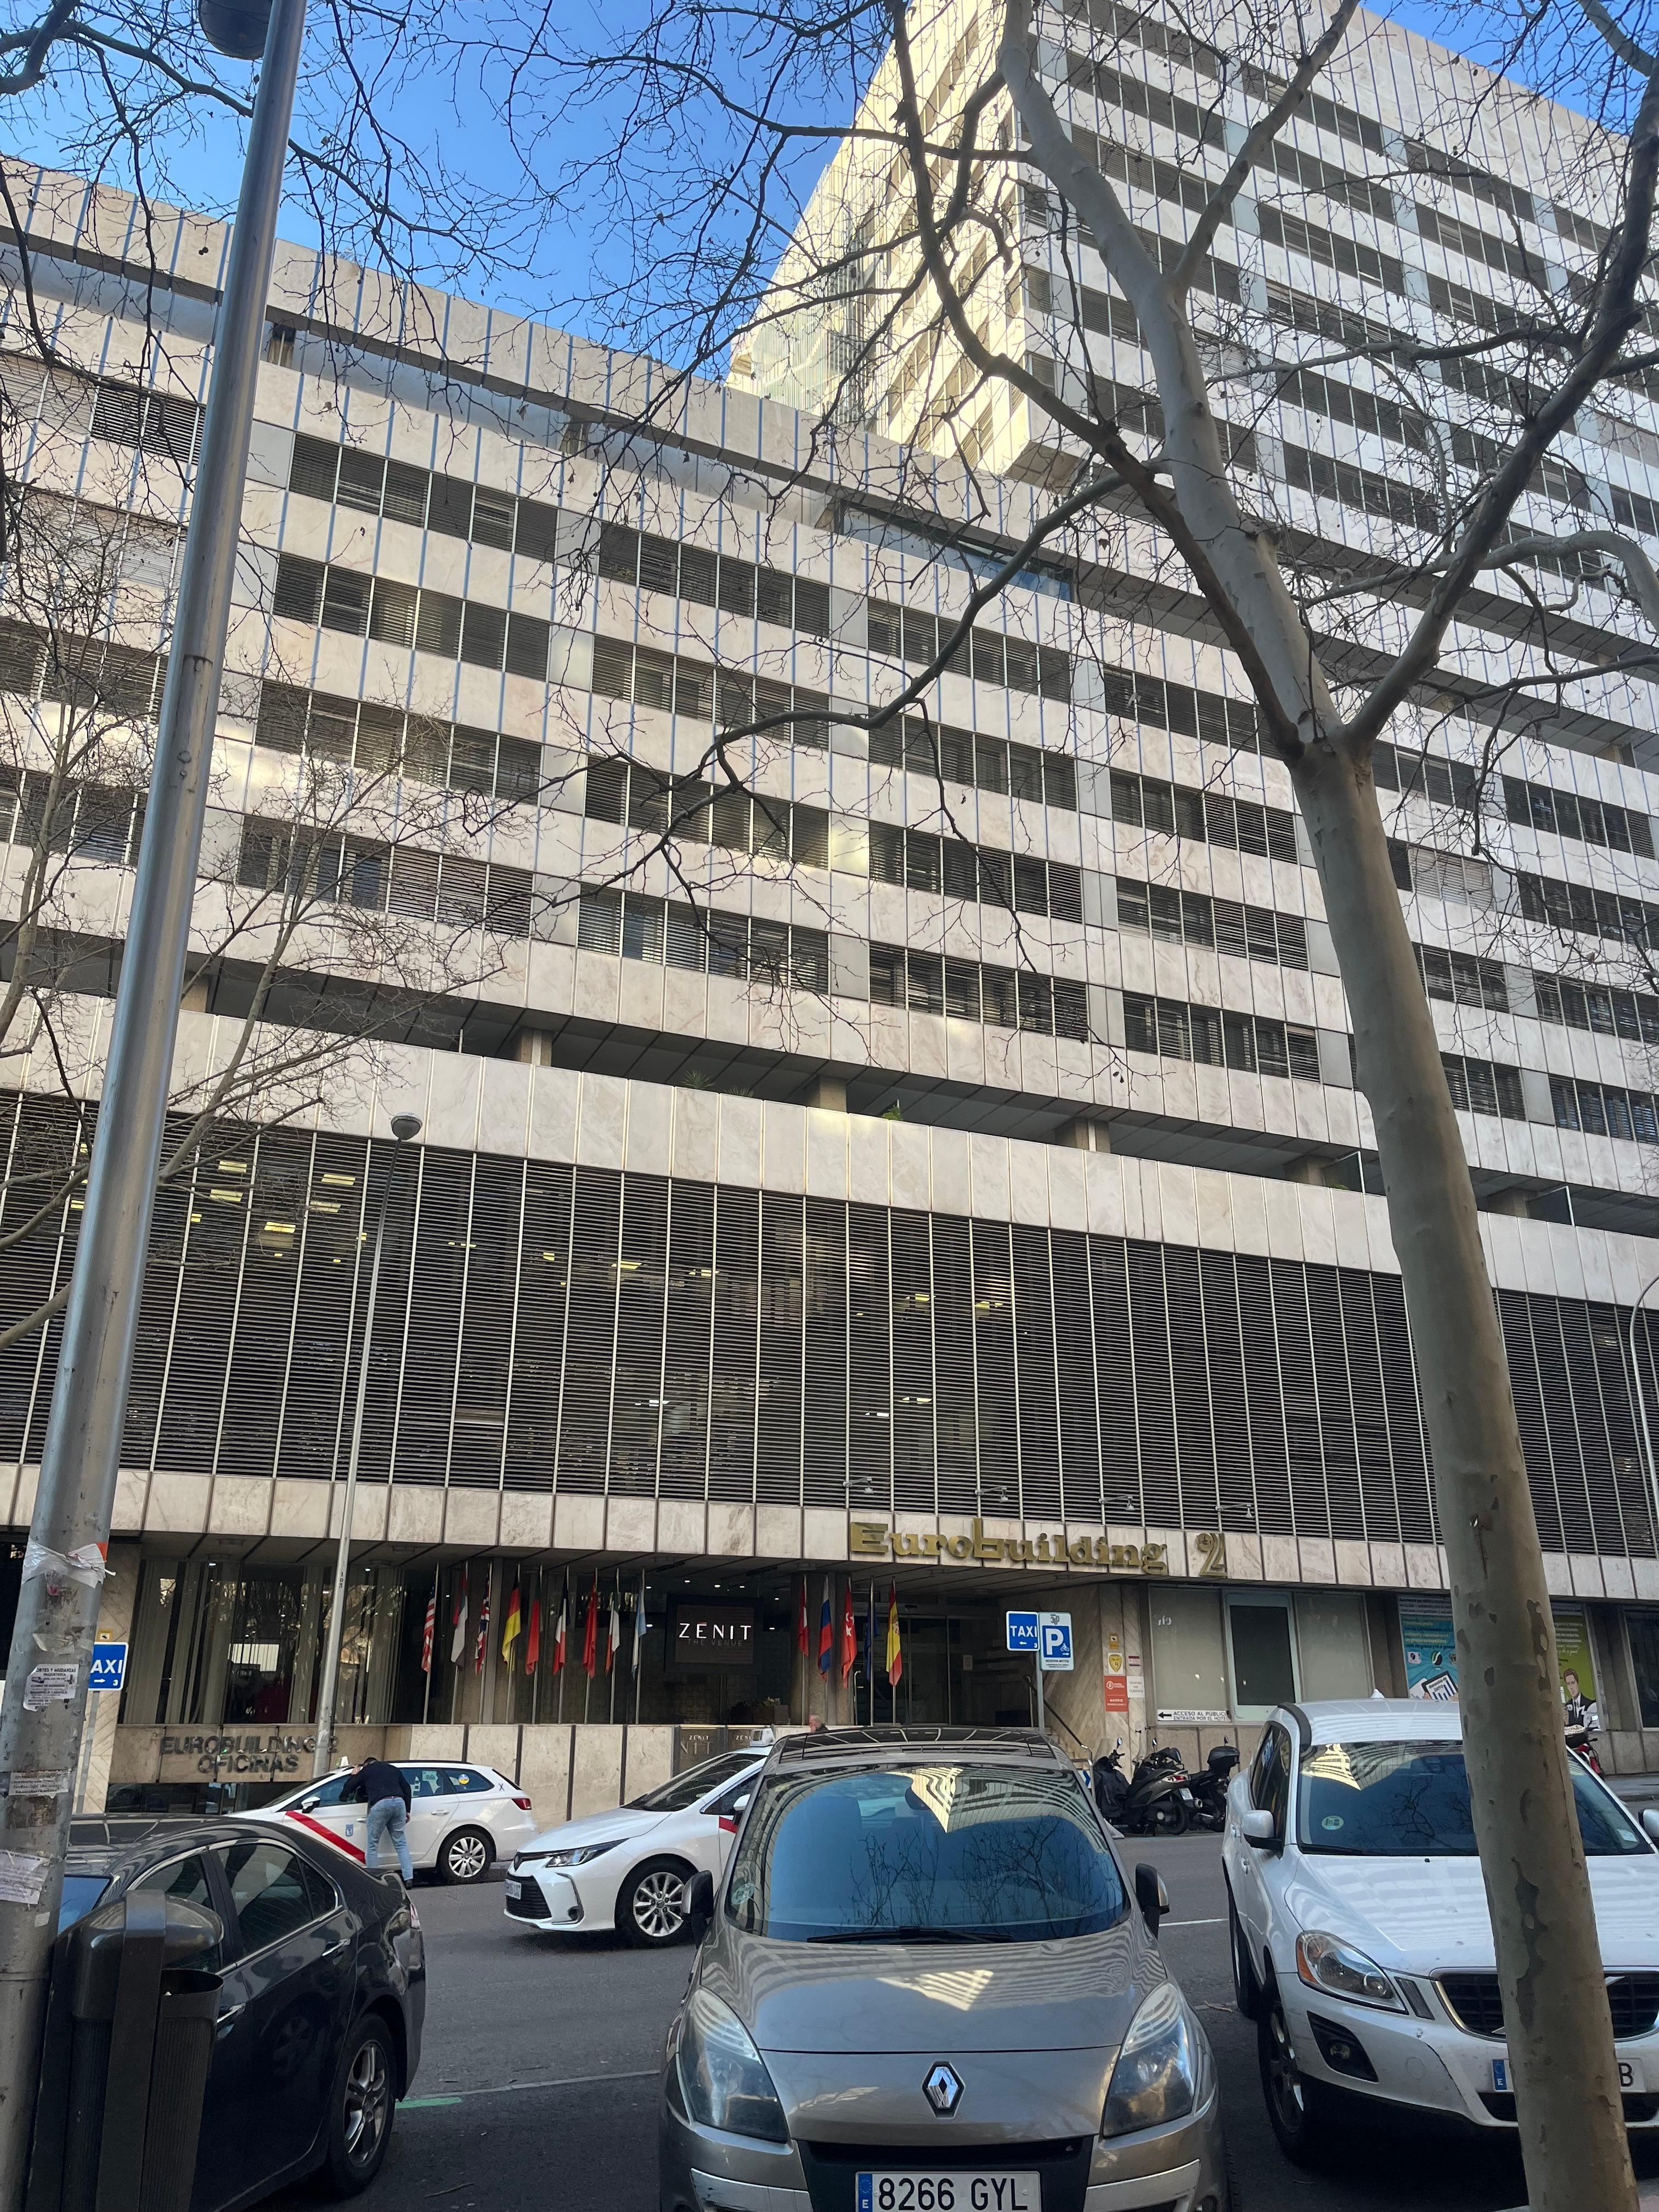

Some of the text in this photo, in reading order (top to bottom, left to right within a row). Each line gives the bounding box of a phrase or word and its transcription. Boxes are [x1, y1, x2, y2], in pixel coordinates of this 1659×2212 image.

[851, 1518, 1227, 1577] Eurobuilding 2
[679, 1622, 752, 1640] ZENIT
[1010, 1626, 1038, 1638] TAXI
[1045, 1628, 1064, 1655] P
[90, 1659, 123, 1674] AXI
[161, 1735, 317, 1754] EUROBUILDING
[198, 1754, 298, 1774] OFICINAS
[878, 2177, 1028, 2211] 8266 GYL
[862, 2199, 869, 2209] E
